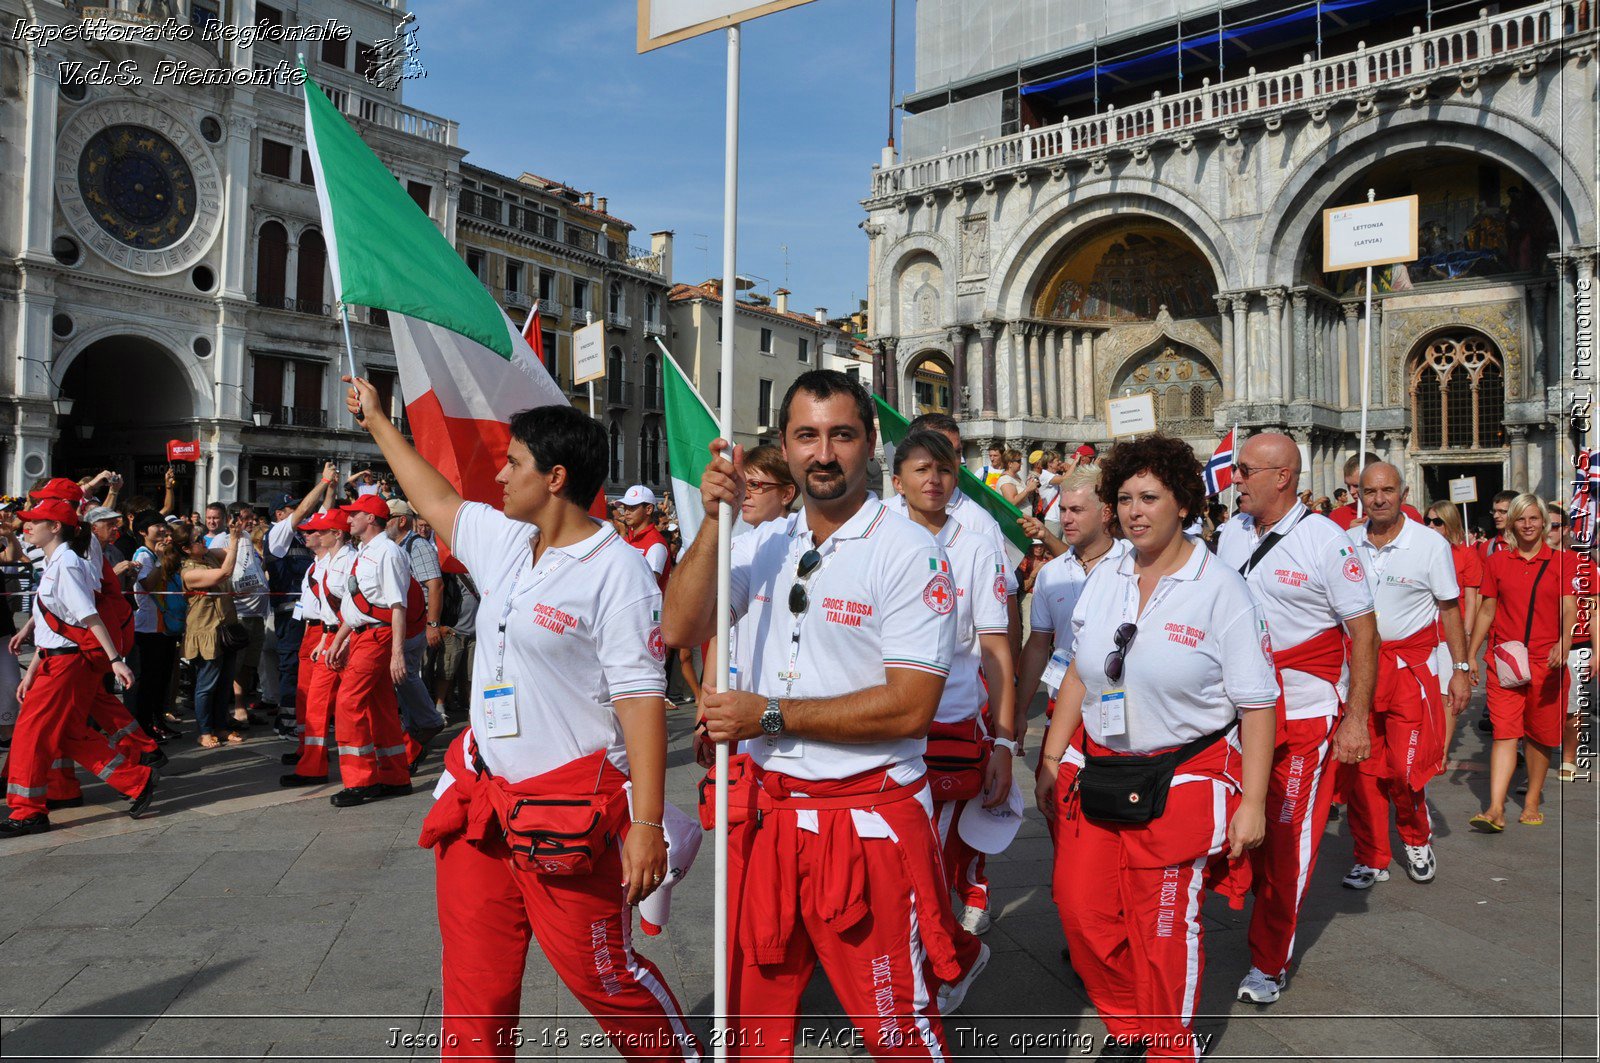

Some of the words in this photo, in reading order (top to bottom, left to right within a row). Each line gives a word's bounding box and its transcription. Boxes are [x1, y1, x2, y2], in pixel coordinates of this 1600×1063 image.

[1352, 221, 1384, 232] LETTONIA
[1353, 237, 1383, 248] (LATVIA)
[261, 465, 291, 477] BAR
[533, 602, 556, 618] CROCE
[554, 607, 579, 630] ROSSA
[822, 597, 845, 612] CROCE
[846, 601, 873, 617] ROSSA
[533, 613, 566, 636] ITALIANA
[826, 611, 861, 628] ITALIANA
[1164, 622, 1186, 634] CROCE
[1185, 625, 1206, 642] ROSSA
[1168, 632, 1198, 648] ITALIANA
[1159, 881, 1179, 907] ROSSA
[1156, 908, 1175, 938] ITALIANA
[871, 954, 892, 987] CROCE
[875, 984, 896, 1018] ROSSA
